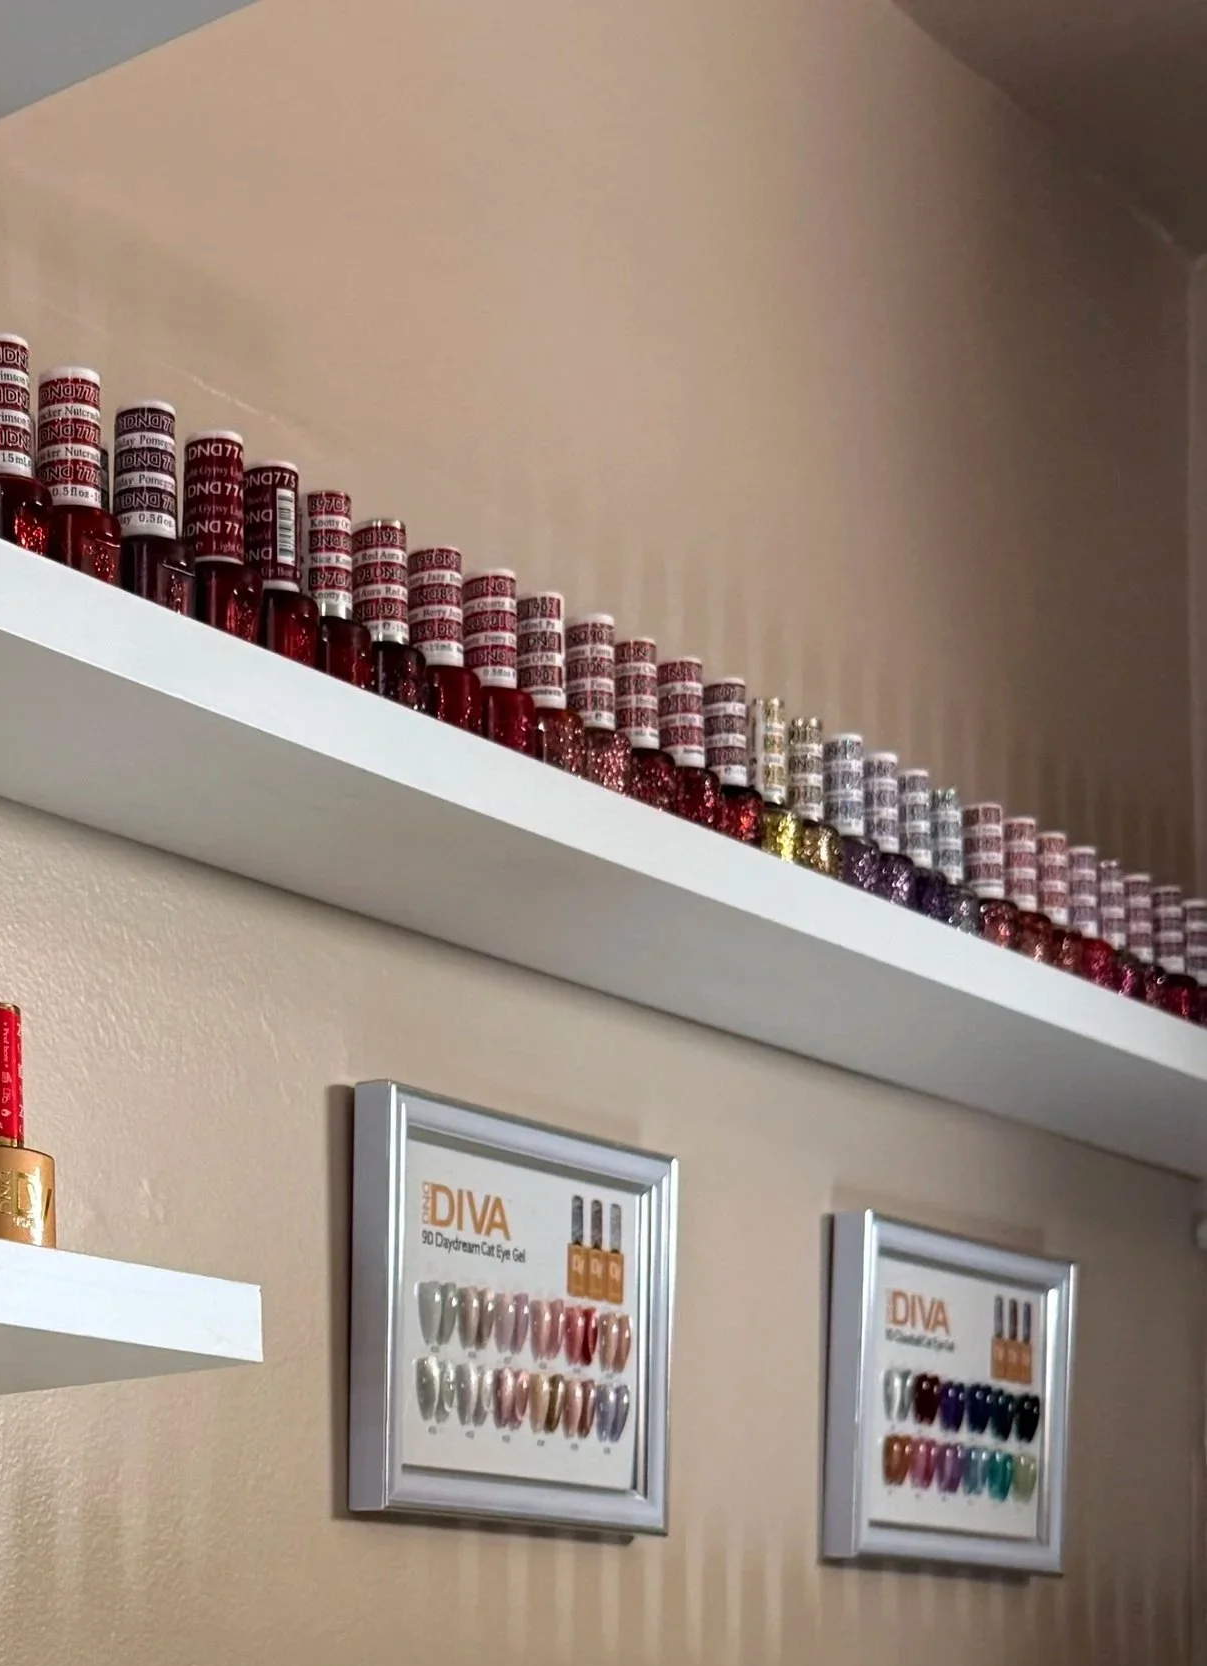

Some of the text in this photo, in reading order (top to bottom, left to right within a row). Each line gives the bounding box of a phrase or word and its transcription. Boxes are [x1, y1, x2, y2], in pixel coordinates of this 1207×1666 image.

[430, 1183, 512, 1241] DIVA
[436, 1232, 480, 1255] Daydream
[481, 1242, 494, 1257] Cat
[497, 1244, 510, 1263] Eye
[512, 1247, 526, 1263] Gel
[891, 1291, 951, 1337] DIVA
